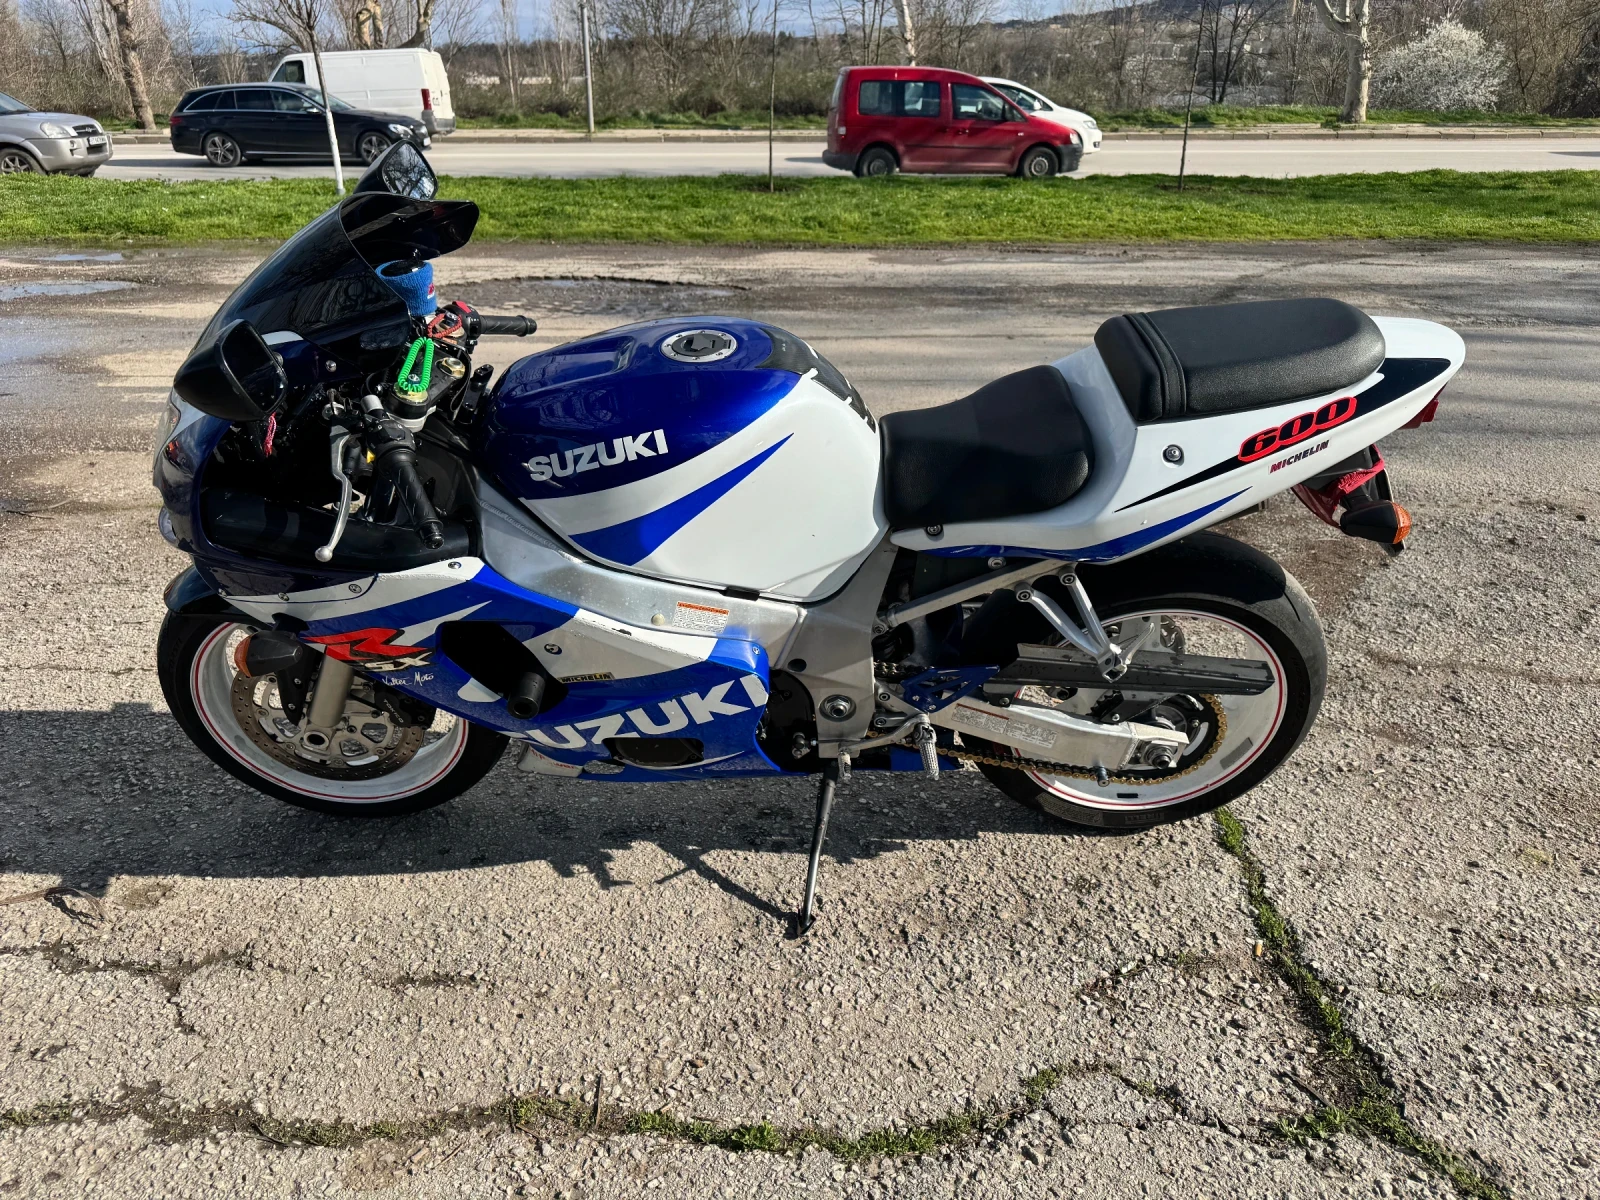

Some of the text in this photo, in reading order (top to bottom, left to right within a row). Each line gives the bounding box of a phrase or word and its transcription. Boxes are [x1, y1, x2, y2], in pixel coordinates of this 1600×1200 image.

[1238, 396, 1358, 462] 600
[528, 428, 669, 482] SUZUKI
[1269, 439, 1330, 474] MICHELIN
[413, 671, 435, 687] Moto
[560, 673, 612, 684] MICHELIN
[498, 672, 769, 749] UZUKI
